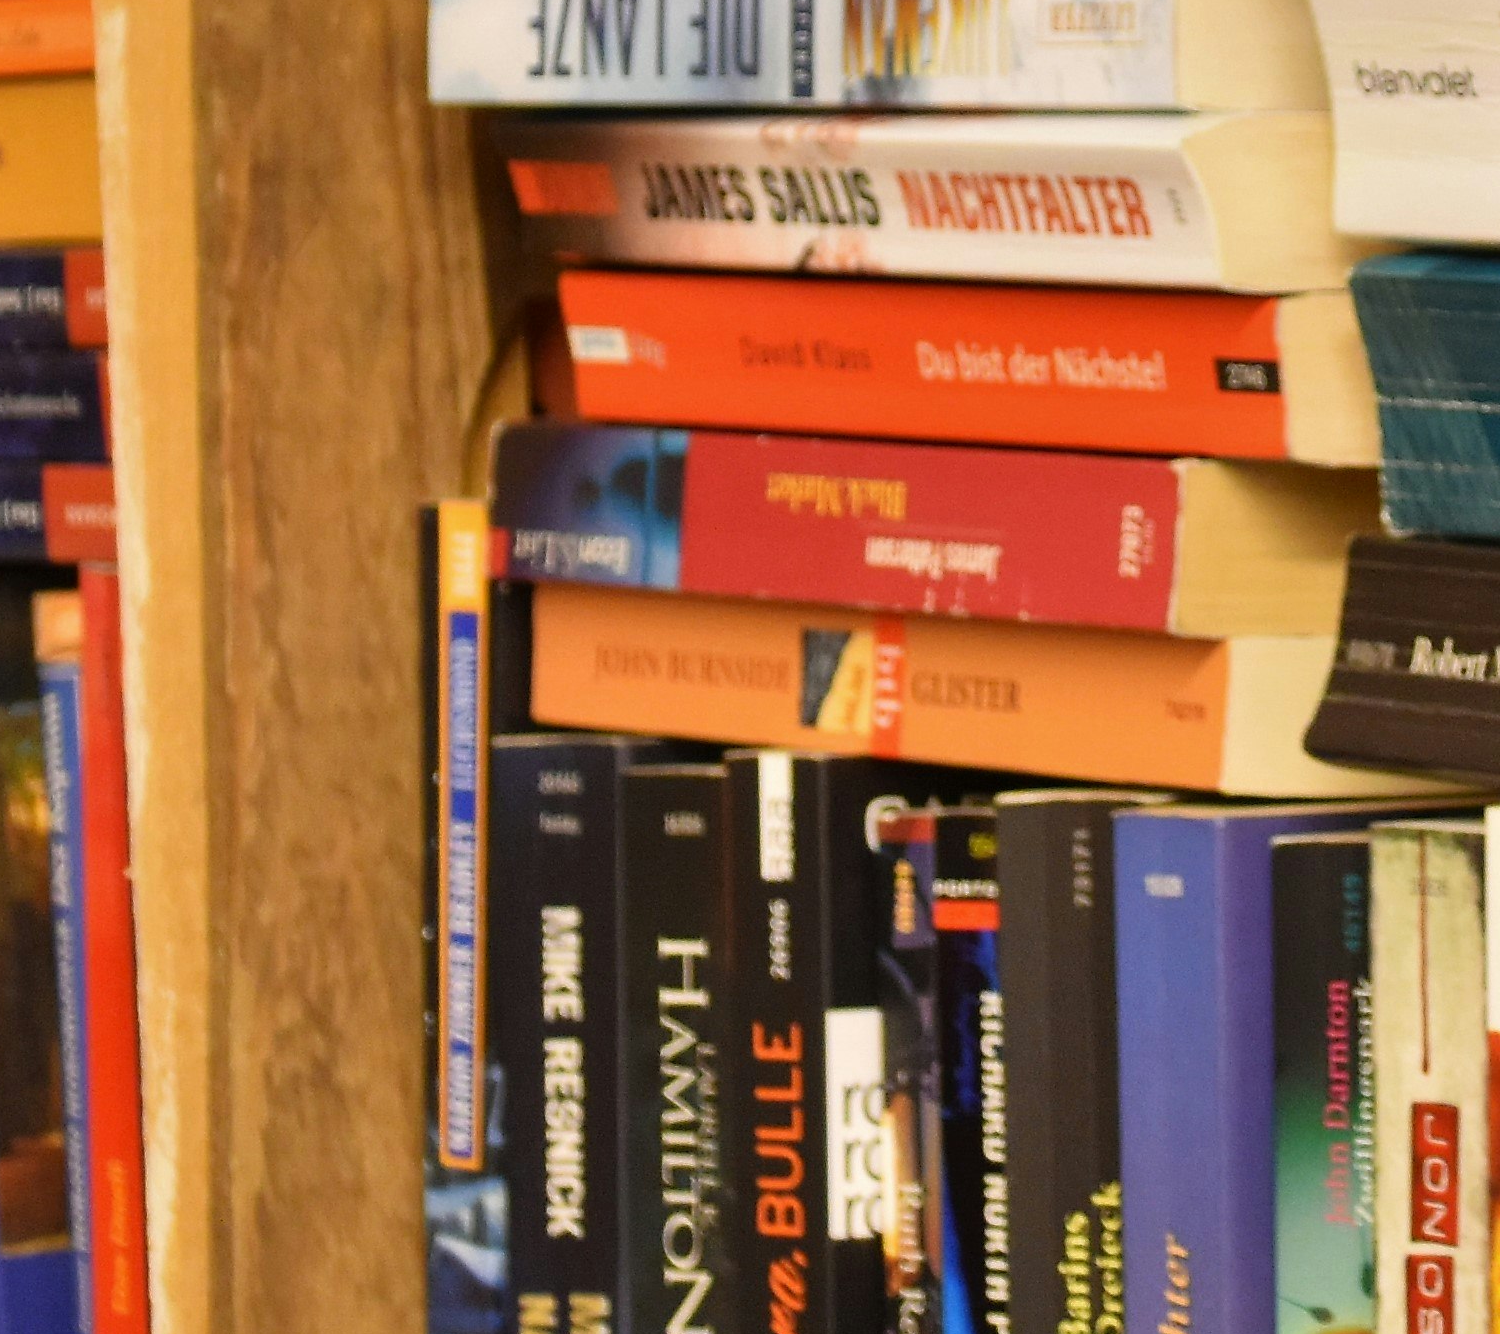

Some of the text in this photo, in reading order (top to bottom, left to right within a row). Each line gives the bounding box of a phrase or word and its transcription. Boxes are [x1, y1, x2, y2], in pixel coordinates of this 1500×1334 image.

[640, 162, 1153, 240] JAMES SALLIS NACHTFALTER
[917, 335, 958, 379] Du
[1409, 636, 1489, 679] Robert
[541, 906, 586, 1242] MIKE RESNICK
[751, 1019, 808, 1238] BULLE
